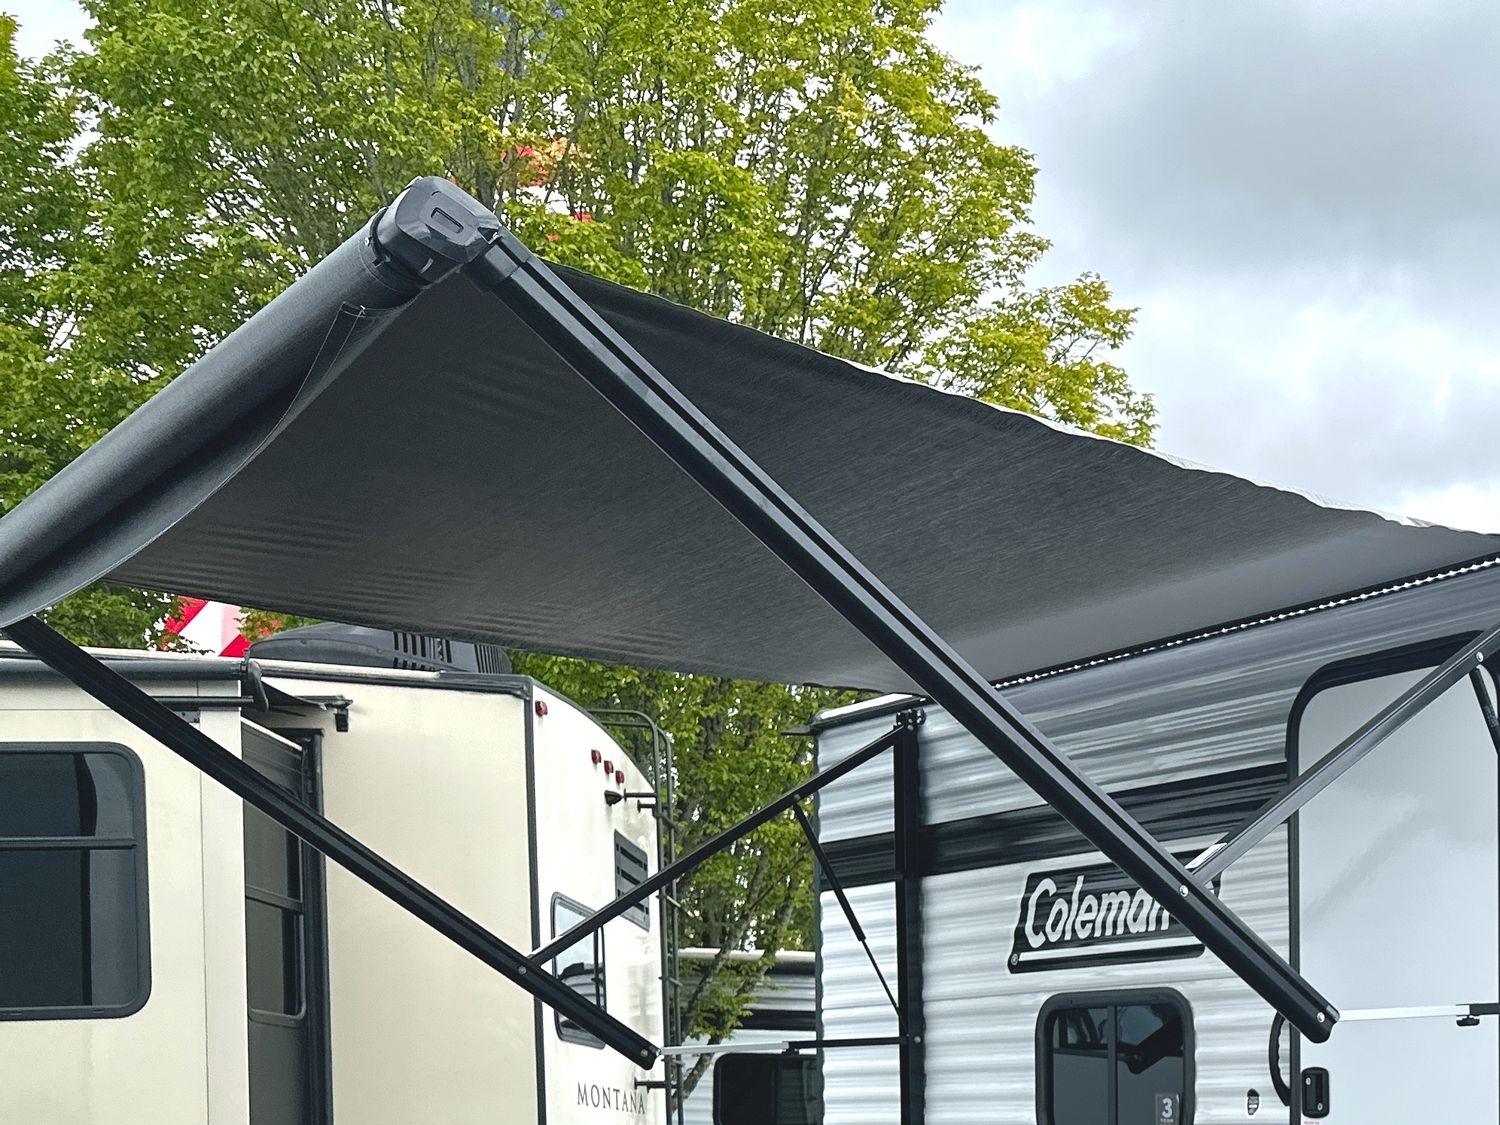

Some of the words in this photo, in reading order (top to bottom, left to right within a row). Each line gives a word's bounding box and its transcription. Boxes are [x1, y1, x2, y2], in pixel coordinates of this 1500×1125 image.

[1024, 875, 1171, 949] Coleman
[577, 1081, 645, 1115] MONTANA
[1162, 1097, 1173, 1118] 3
